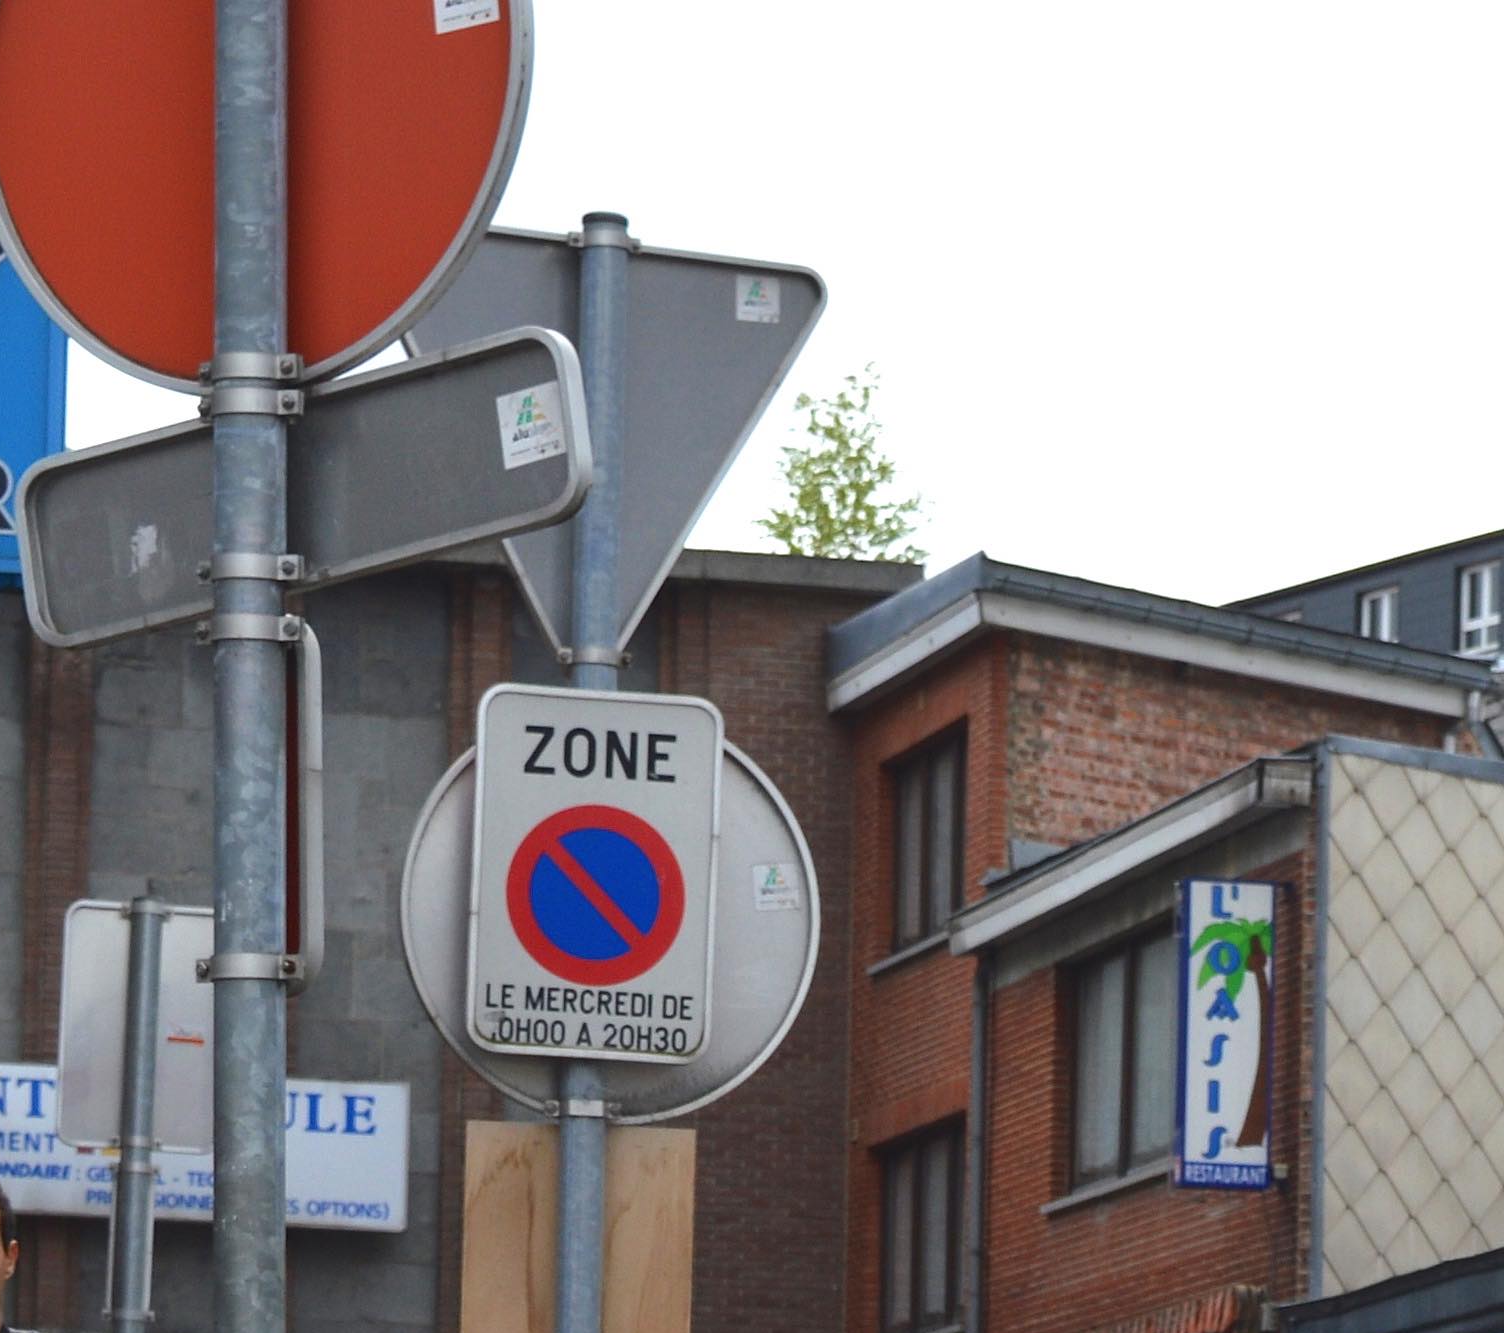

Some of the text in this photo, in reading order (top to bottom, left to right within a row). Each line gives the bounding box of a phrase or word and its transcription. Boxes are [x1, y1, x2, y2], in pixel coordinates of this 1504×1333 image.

[523, 724, 678, 783] ZONE
[485, 984, 694, 1021] LE MERCREDI DE
[491, 1017, 687, 1053] 0H00 A 20H30
[1202, 885, 1242, 1160] L'OASIS
[1184, 1163, 1267, 1185] RESTAURANT
[307, 1200, 390, 1220] OPTIONS)
